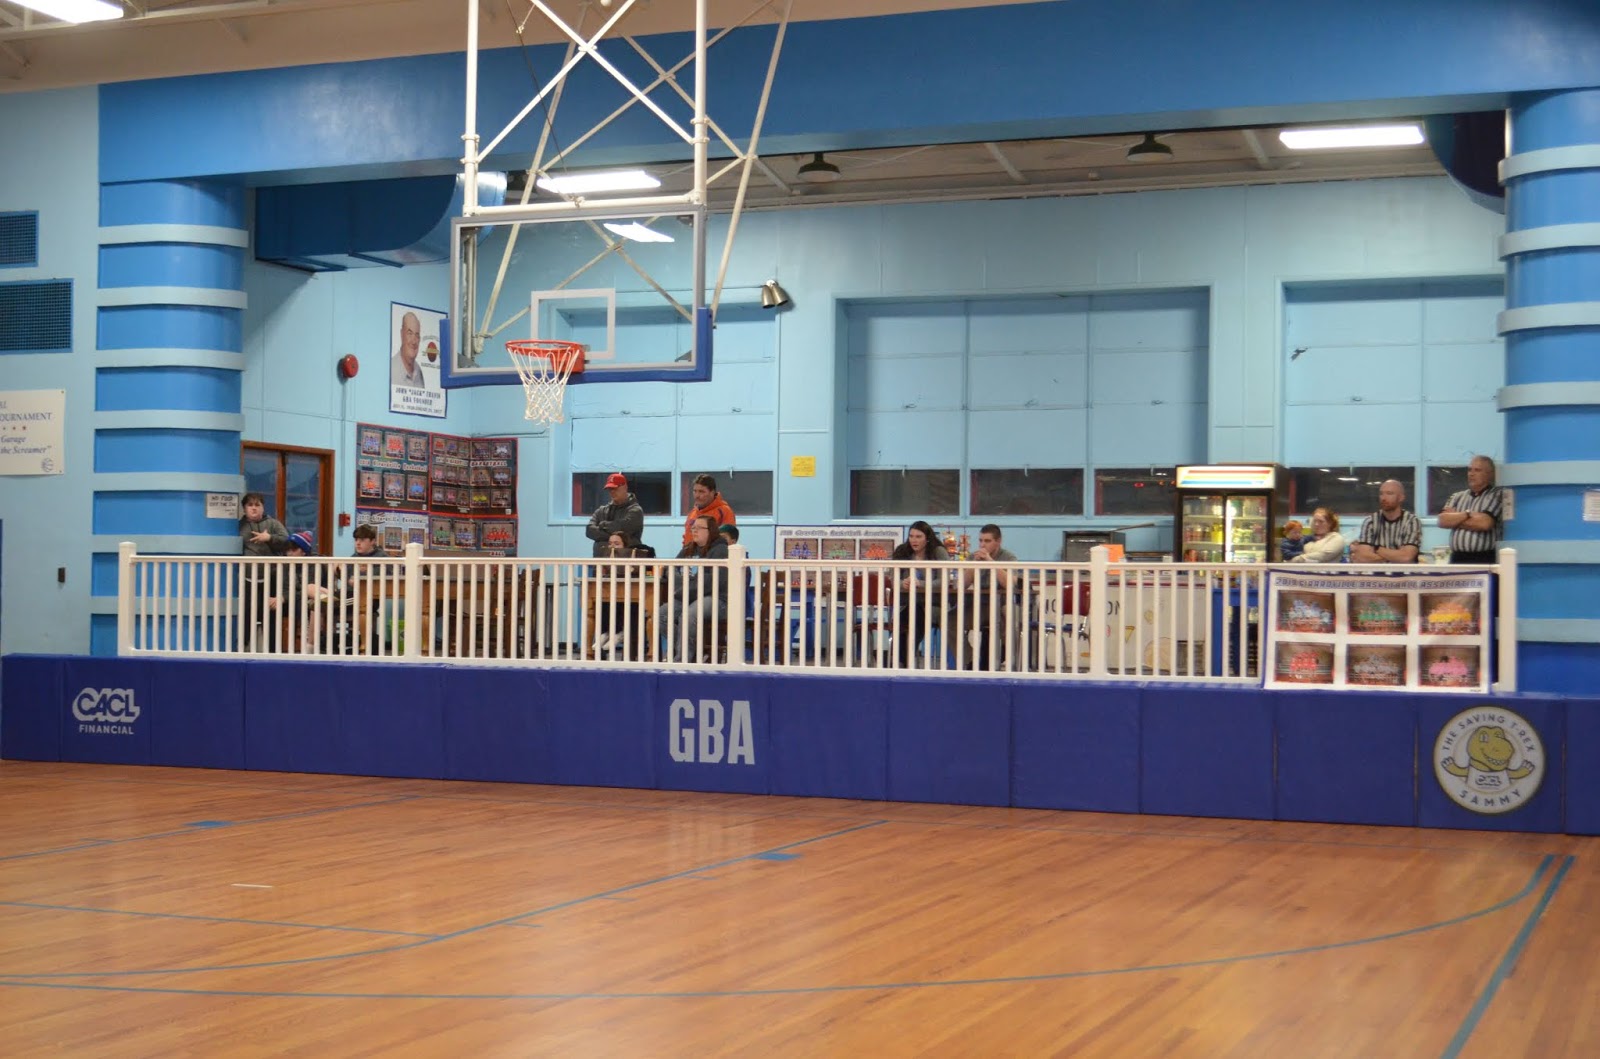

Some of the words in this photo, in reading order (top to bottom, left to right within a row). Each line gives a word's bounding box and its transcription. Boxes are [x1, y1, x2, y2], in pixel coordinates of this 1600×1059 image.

[0, 435, 26, 444] Garage
[0, 446, 11, 455] the
[71, 687, 141, 723] CACL
[78, 725, 134, 735] FINANCIAL
[669, 699, 755, 766] GBA
[1442, 730, 1457, 751] THE
[1458, 713, 1505, 730] SAVING
[1459, 788, 1521, 807] SAMMY
